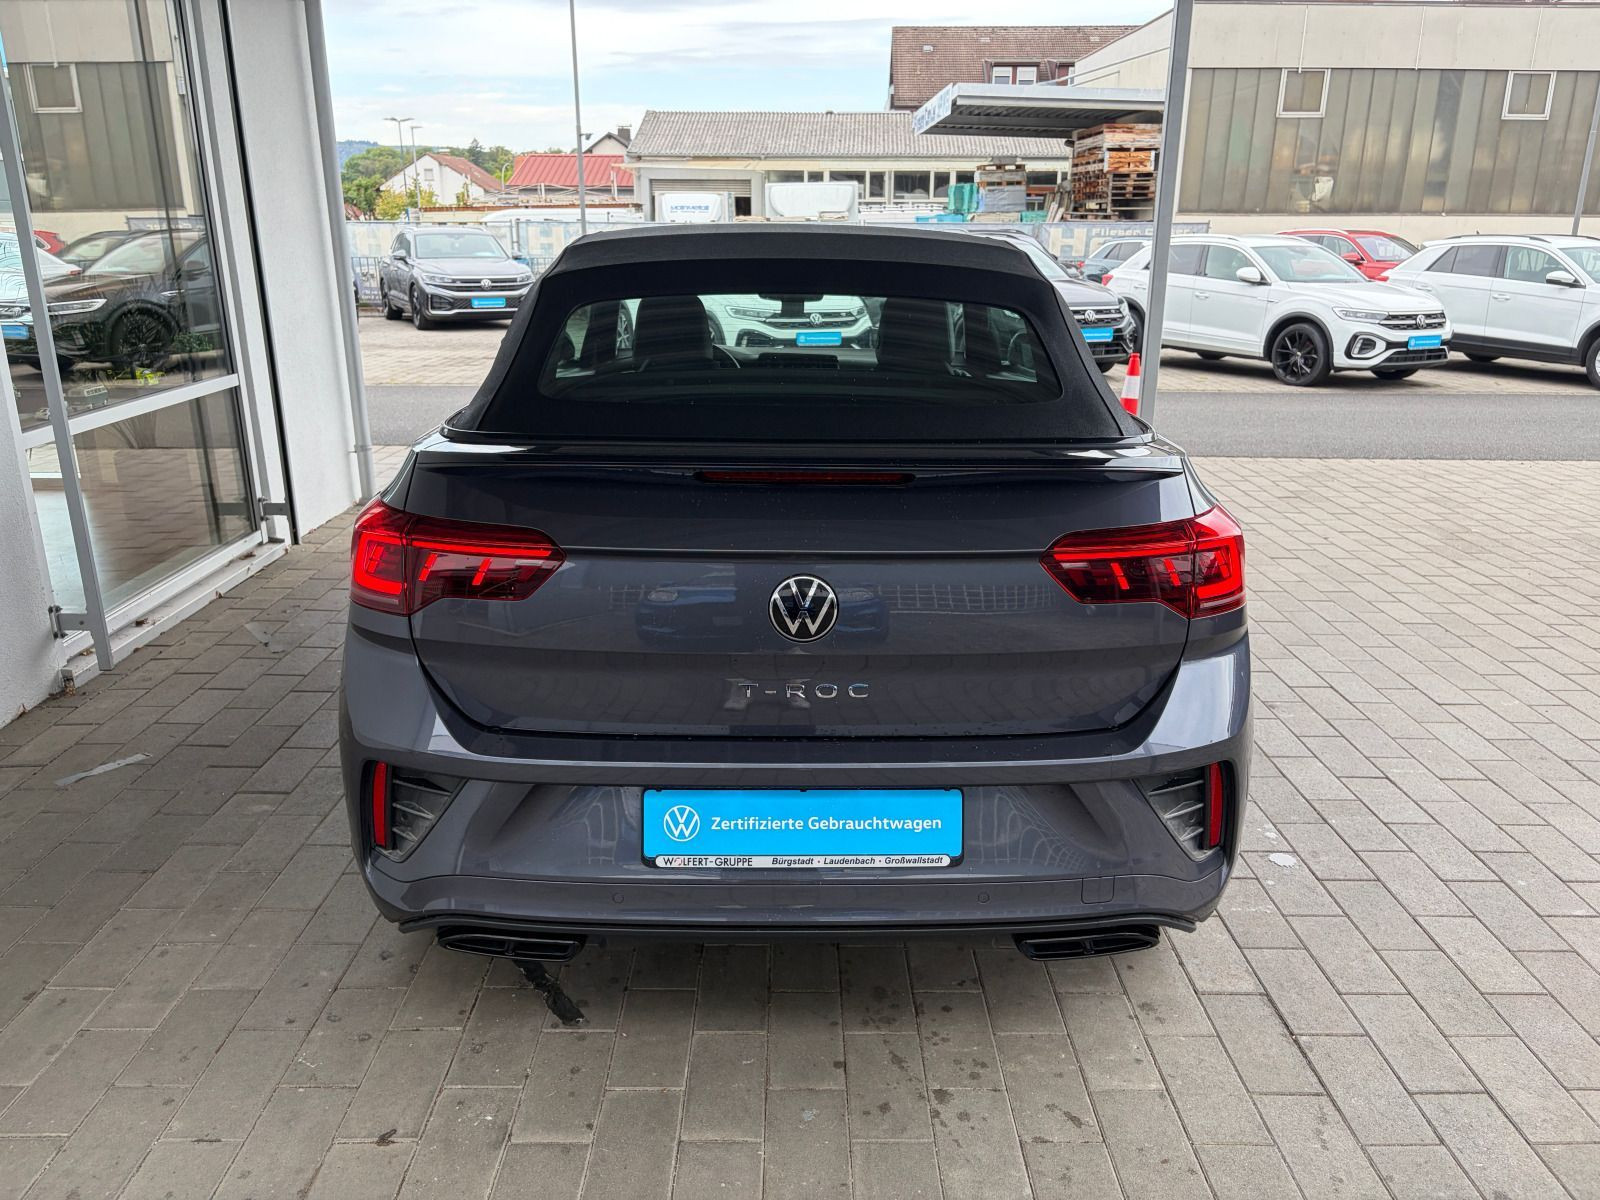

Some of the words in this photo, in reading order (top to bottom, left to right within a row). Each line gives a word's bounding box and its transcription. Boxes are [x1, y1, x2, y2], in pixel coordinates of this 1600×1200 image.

[769, 575, 838, 643] VW
[738, 683, 869, 698] T-ROC
[663, 804, 701, 842] VW
[711, 816, 804, 830] Zertifizierte
[808, 816, 942, 832] Gebrauchtwagen
[663, 857, 753, 867] WOLFERT-GRUPPE
[771, 857, 814, 867] Bürgstadt
[823, 857, 876, 865] Laudenbach
[884, 856, 944, 865] Großwallstadt
